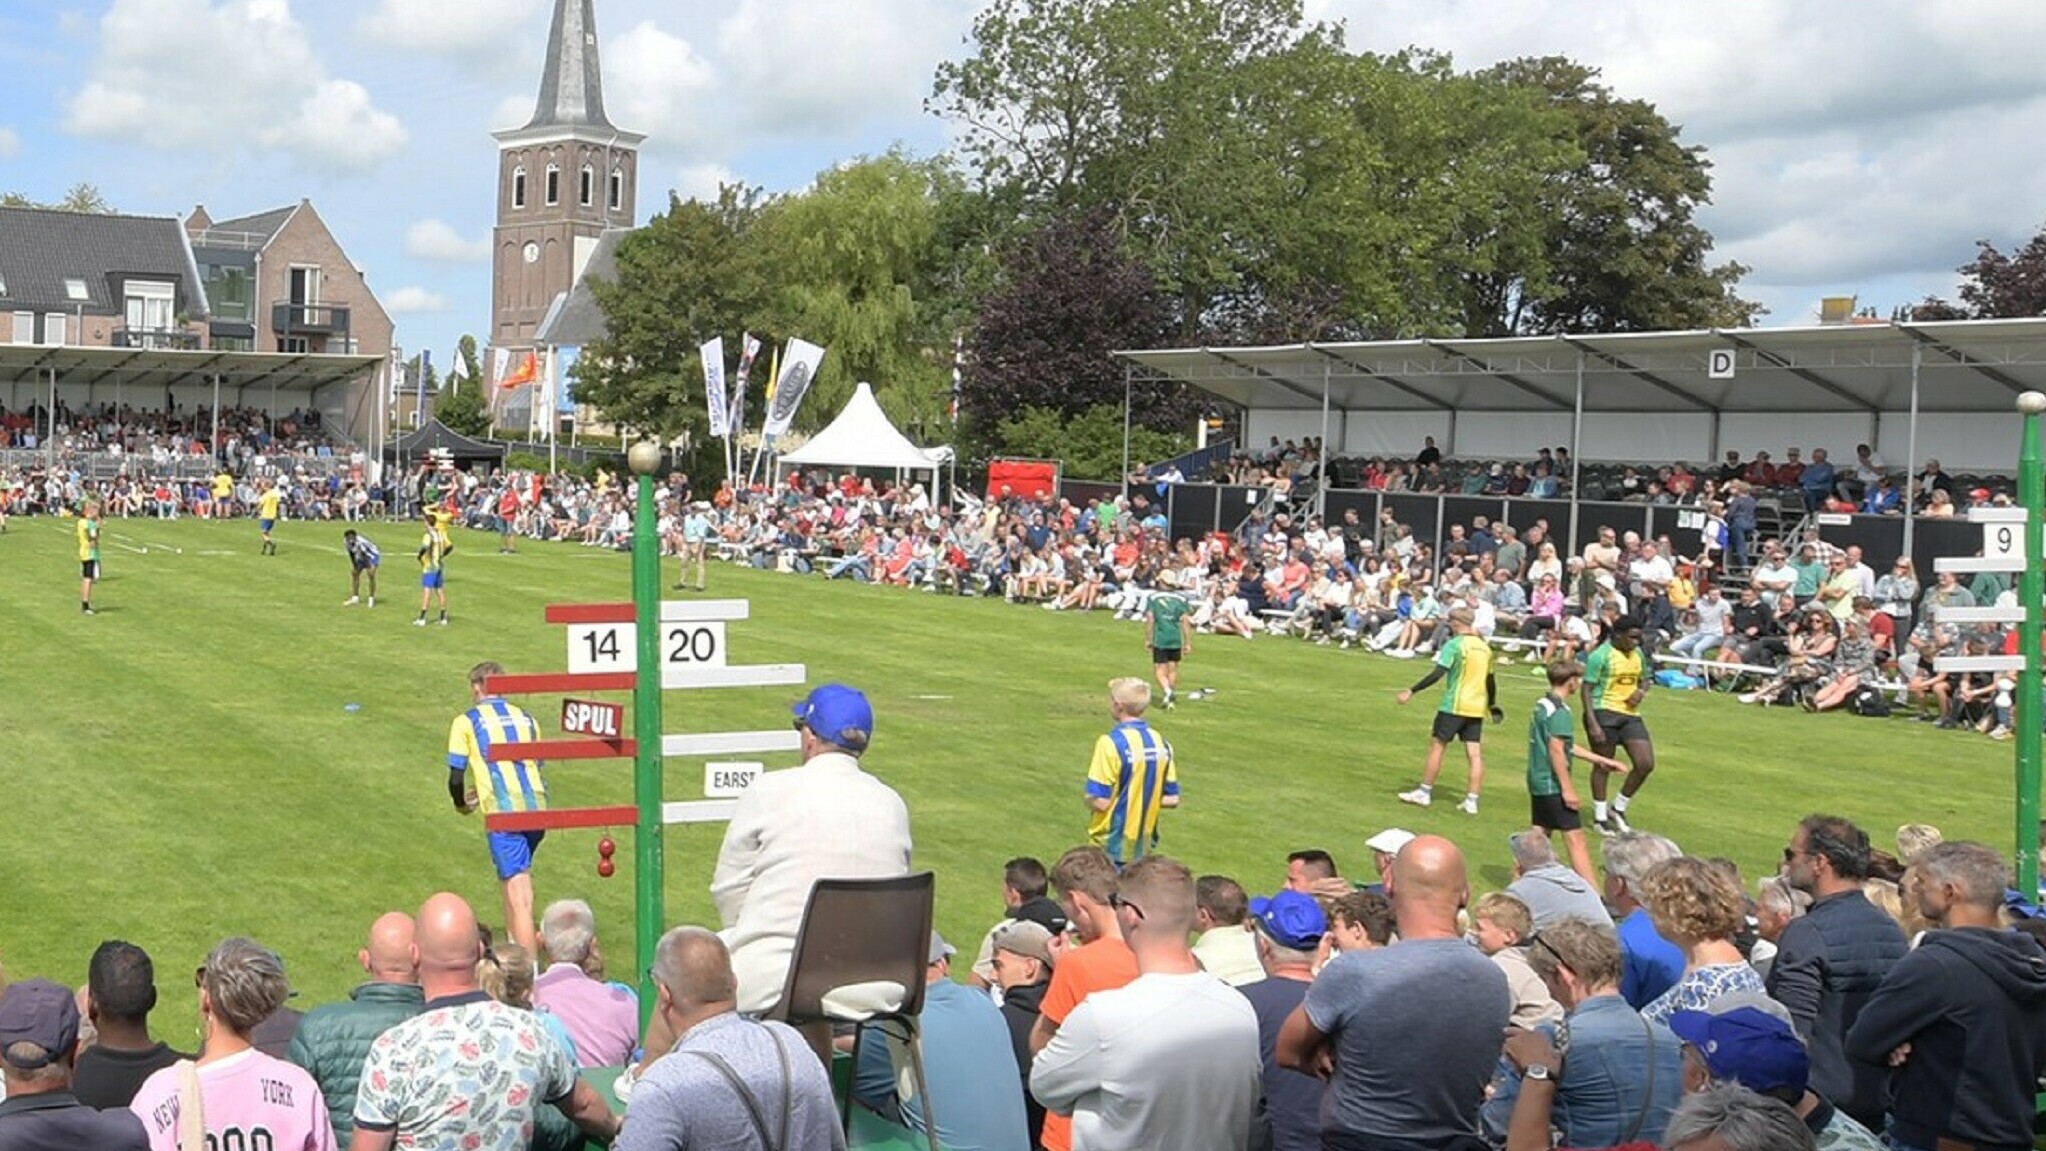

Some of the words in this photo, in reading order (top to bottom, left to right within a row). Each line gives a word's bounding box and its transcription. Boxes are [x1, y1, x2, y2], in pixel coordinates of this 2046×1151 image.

[1714, 352, 1731, 373] D
[1997, 527, 2012, 553] 9
[583, 628, 621, 663] 14
[668, 627, 715, 662] 20
[564, 702, 618, 736] SPUL
[153, 1094, 180, 1135] NEW
[261, 1078, 294, 1107] YORK
